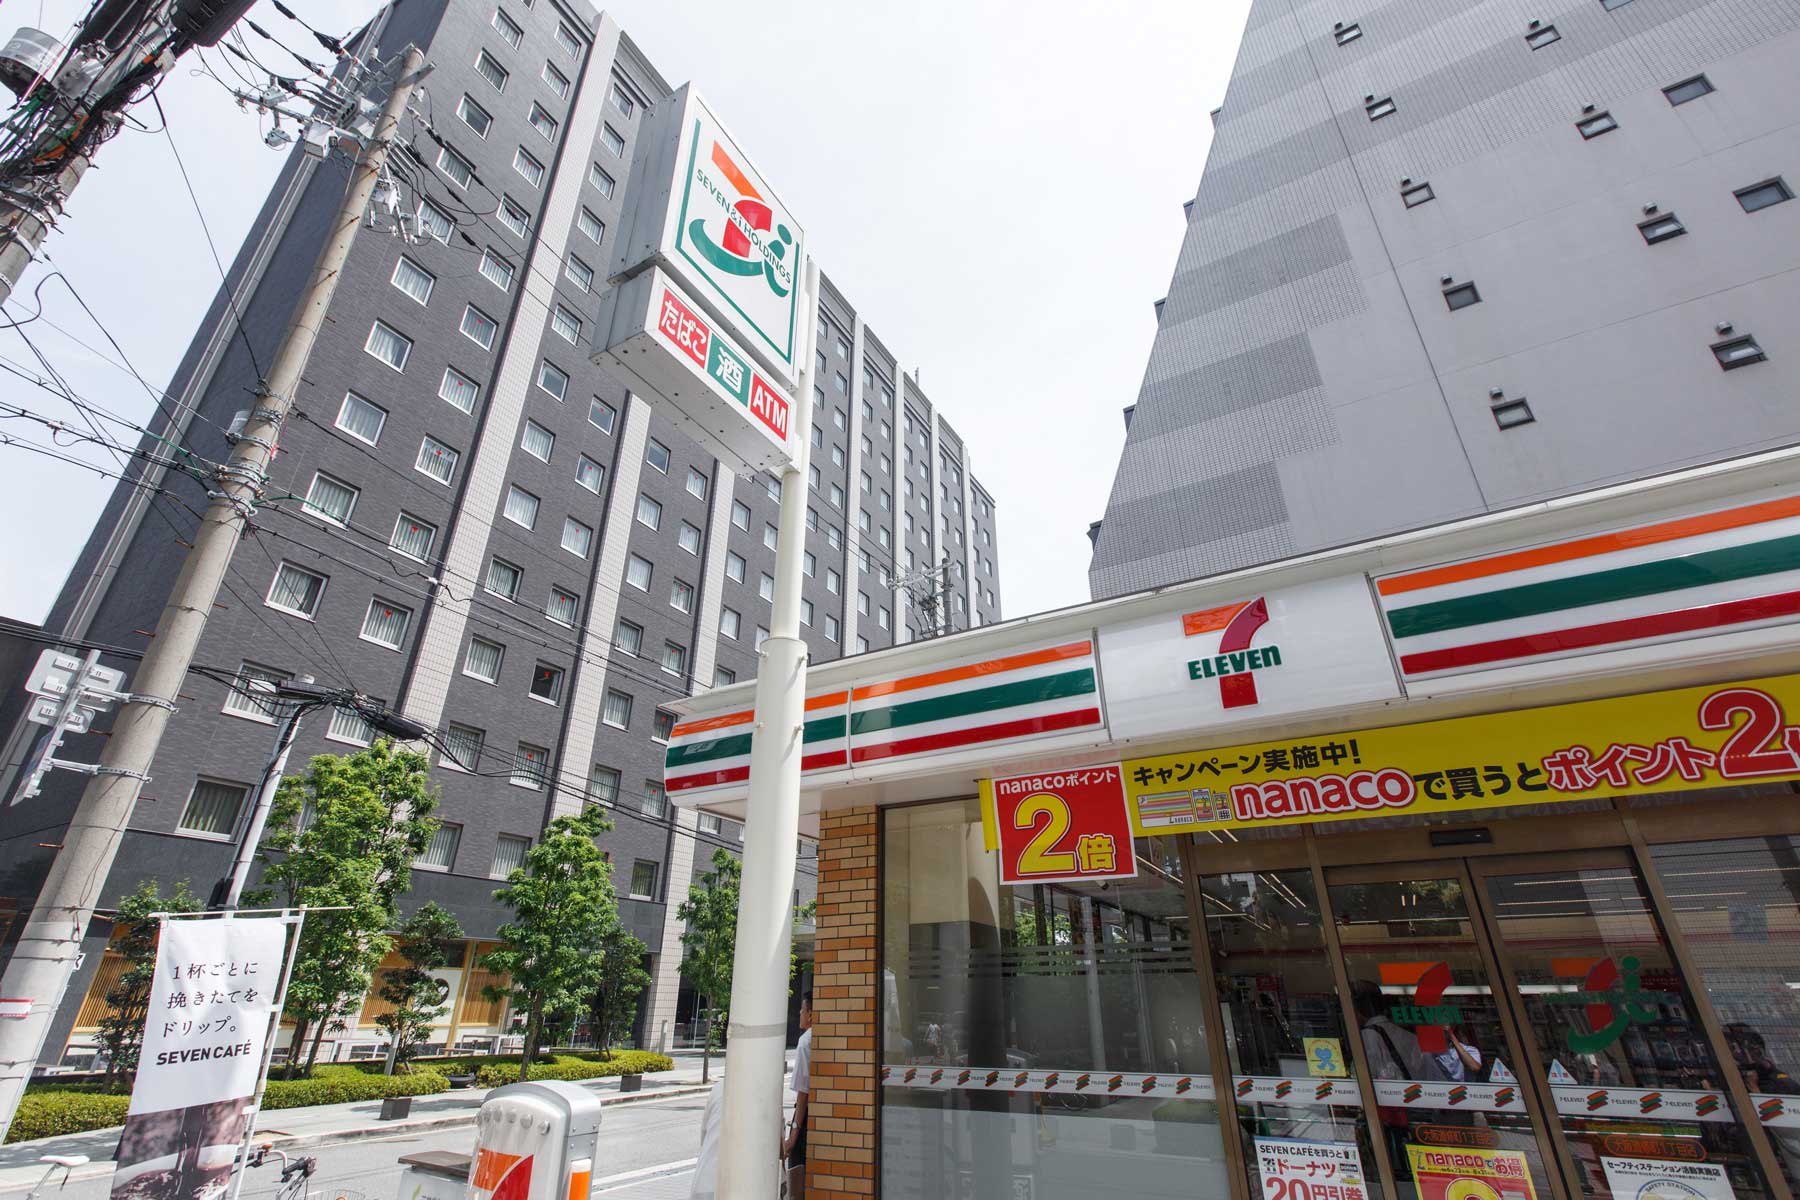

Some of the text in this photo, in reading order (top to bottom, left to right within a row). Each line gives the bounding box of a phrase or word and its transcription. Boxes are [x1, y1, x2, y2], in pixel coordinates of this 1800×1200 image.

[744, 223, 791, 284] HOLDINGS
[661, 300, 787, 433] たばこ 酒 ATM
[1014, 791, 1117, 877] 2倍
[167, 988, 259, 1009] 挽きたてを
[163, 1016, 237, 1039] ドリップ。
[156, 1039, 252, 1066] SEVEN CAFÉ
[1260, 1144, 1289, 1156] SEVEN
[1277, 1158, 1336, 1178] ドーナツ
